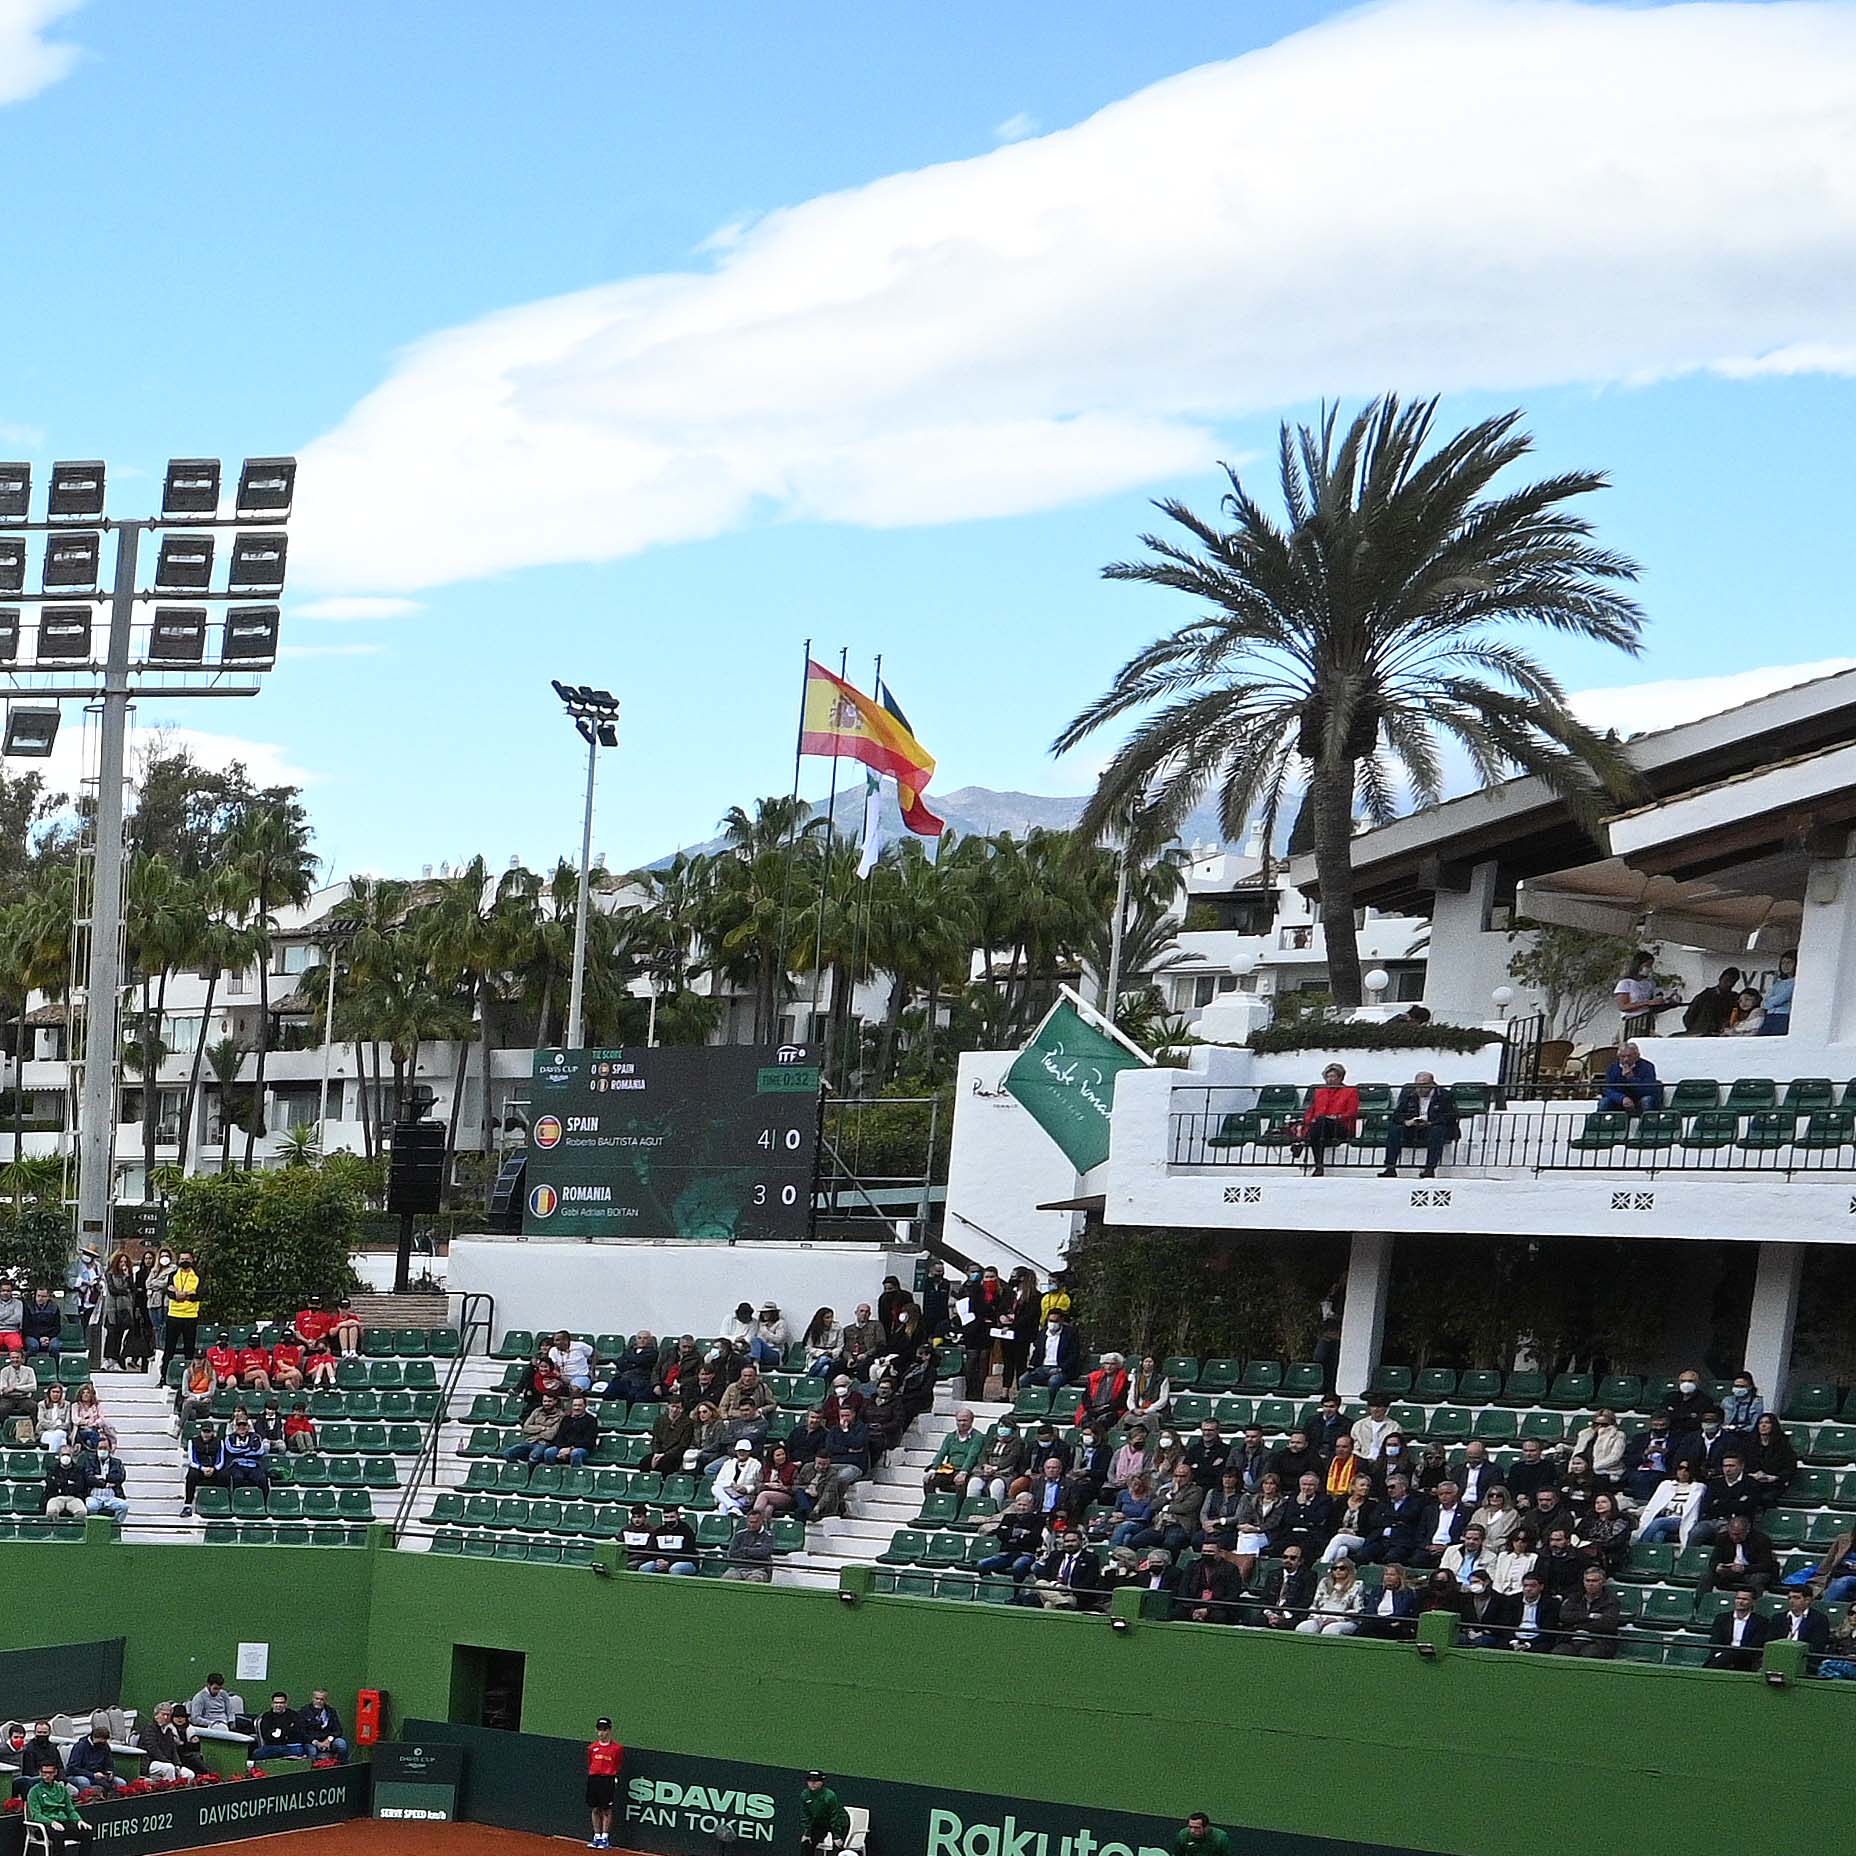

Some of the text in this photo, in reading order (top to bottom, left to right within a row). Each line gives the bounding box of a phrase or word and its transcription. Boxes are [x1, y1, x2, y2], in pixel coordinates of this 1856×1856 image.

[778, 1051, 797, 1062] ITF
[611, 1063, 635, 1074] SPAIN
[610, 1079, 646, 1091] ROMANIA
[566, 1116, 599, 1132] SPAIN
[598, 1137, 638, 1147] BAUTISTA
[640, 1136, 664, 1146] AGUT
[757, 1129, 770, 1149] 4
[785, 1129, 801, 1149] 0
[562, 1186, 612, 1201] ROMANIA
[753, 1185, 766, 1205] 3
[781, 1185, 796, 1205] 0
[628, 1777, 775, 1819] $DAVIS
[142, 1813, 174, 1832] 2022
[199, 1787, 346, 1826] DAVISCUPFINALS.COM
[404, 1809, 427, 1819] SPEED
[626, 1805, 775, 1842] FAN TOKEN
